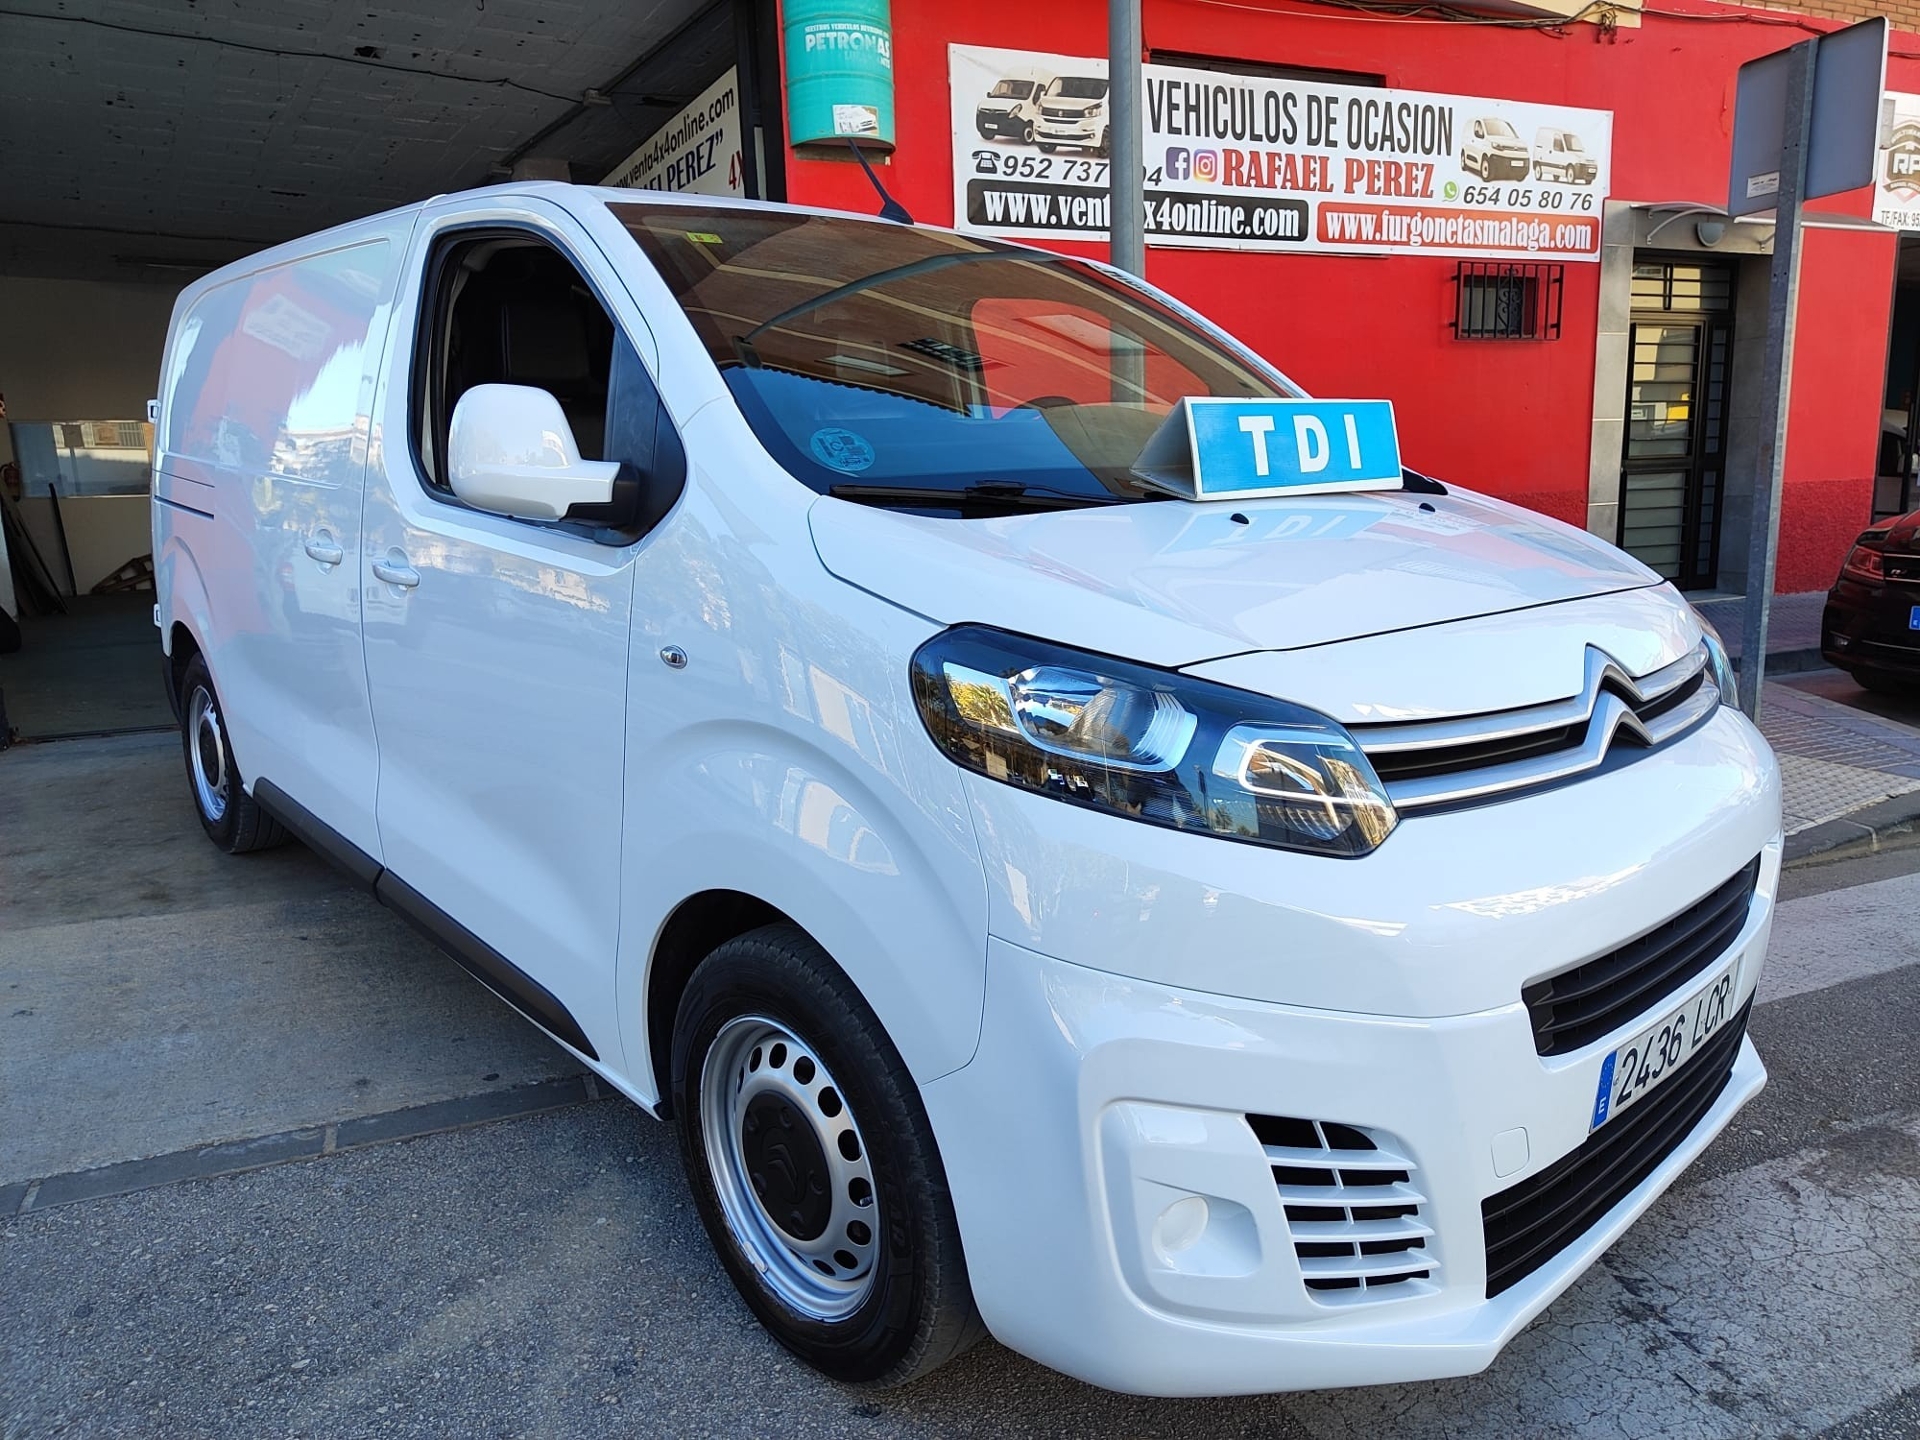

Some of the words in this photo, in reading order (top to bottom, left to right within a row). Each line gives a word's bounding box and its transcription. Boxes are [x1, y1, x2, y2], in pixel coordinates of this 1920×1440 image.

[805, 31, 890, 59] PETRONAS
[1147, 78, 1298, 145] VEHICULOS
[1307, 94, 1339, 148] DE
[1347, 98, 1453, 157] OCASION
[1002, 155, 1053, 179] 952
[1062, 159, 1109, 183] 737
[1221, 148, 1334, 193] RAFAEL
[1343, 157, 1435, 199] PEREZ
[983, 190, 1299, 239] www.ventx4online.com
[1463, 185, 1501, 206] 654
[1507, 188, 1533, 208] 05
[1538, 189, 1563, 210] 80
[1570, 192, 1594, 211] 76
[1911, 212, 1920, 227] 95
[1325, 209, 1592, 250] www.furgonetasmalaga.com
[1237, 413, 1363, 477] TDI
[1615, 1013, 1687, 1108] 2436
[1691, 973, 1731, 1050] LCR
